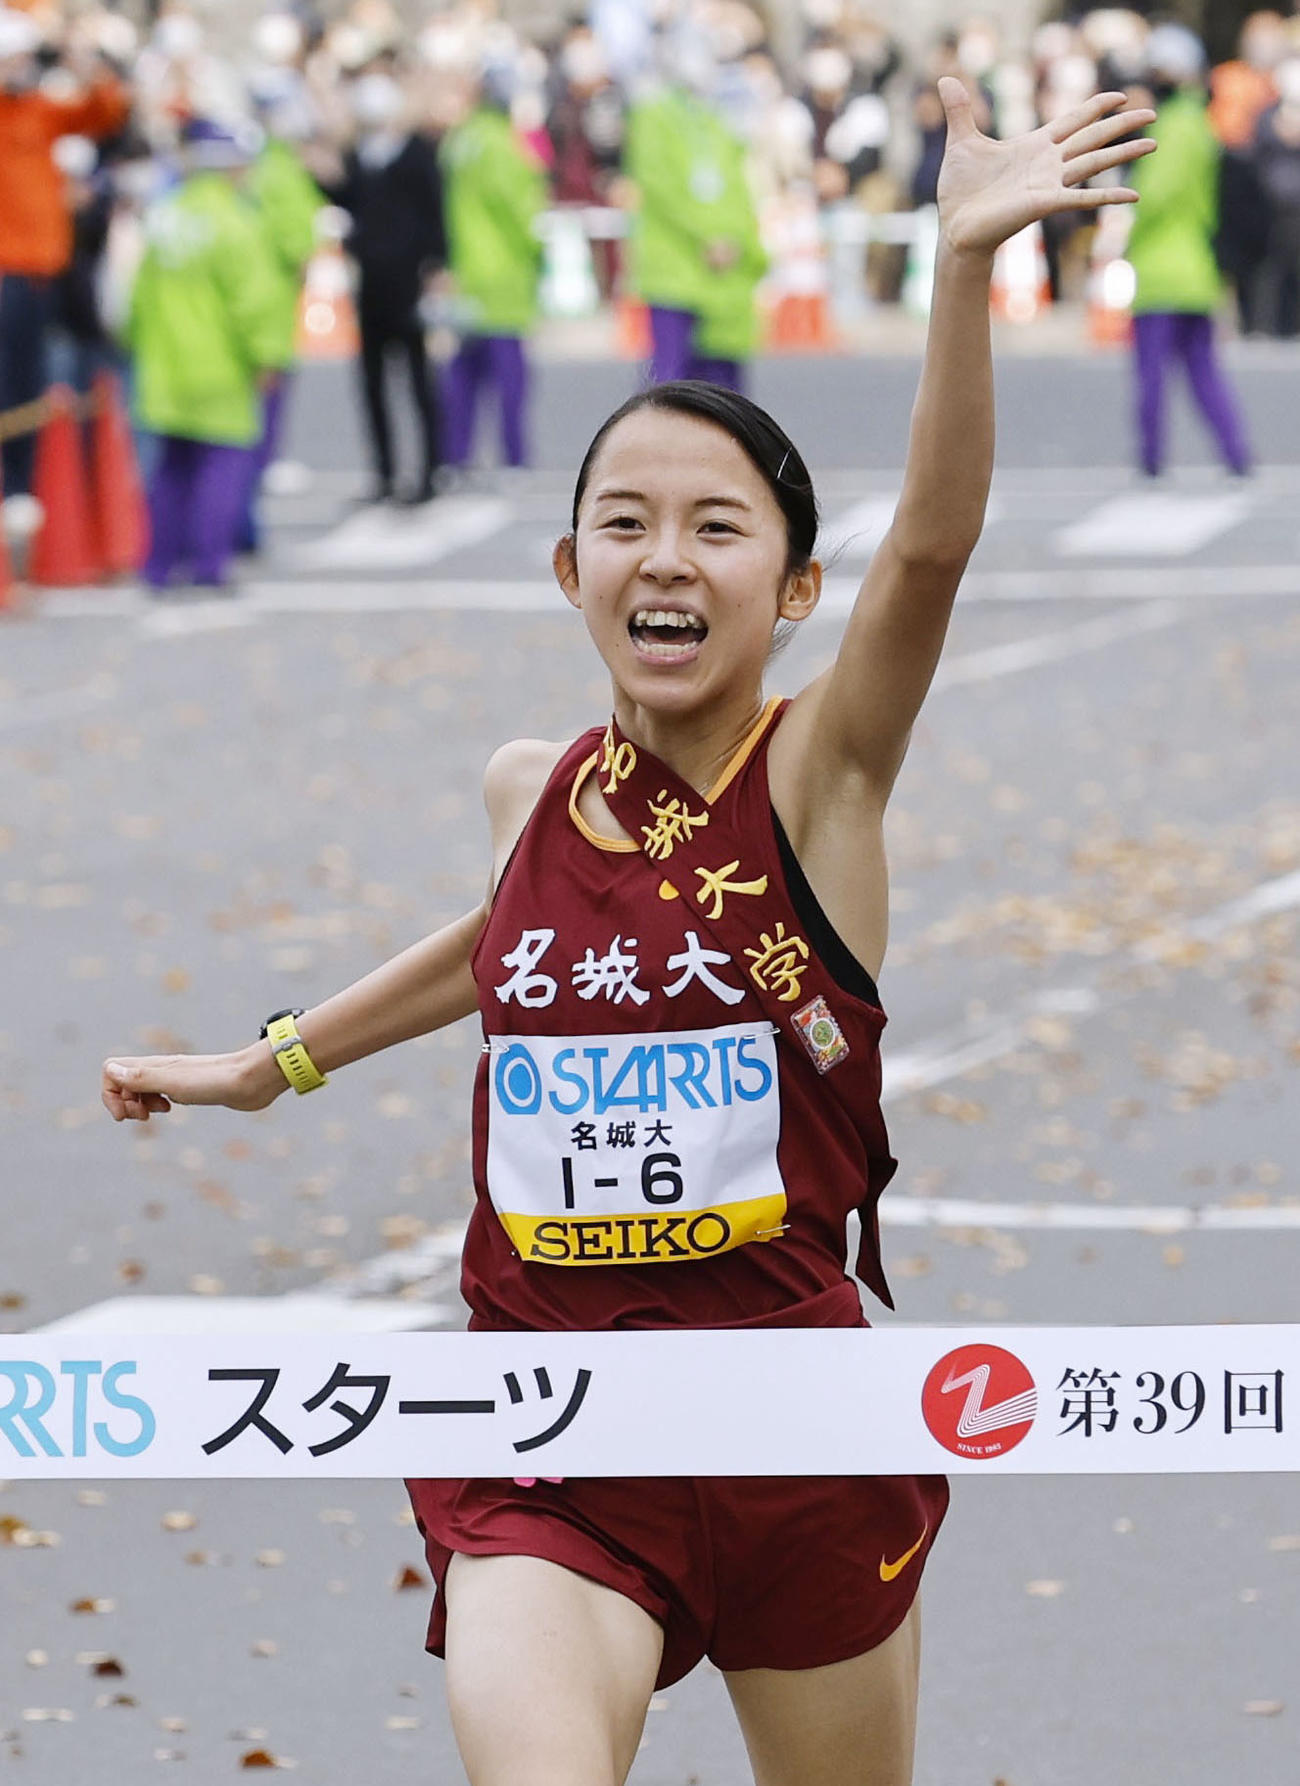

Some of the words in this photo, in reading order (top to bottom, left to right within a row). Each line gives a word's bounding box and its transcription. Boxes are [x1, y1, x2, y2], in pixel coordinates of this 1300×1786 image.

[600, 720, 810, 1001] 名城大学
[494, 928, 746, 1009] 名城大
[571, 1119, 673, 1150] 名城大
[530, 1212, 731, 1260] SEIKO
[200, 1362, 592, 1457] スターツ
[1055, 1367, 1284, 1437] 第39回
